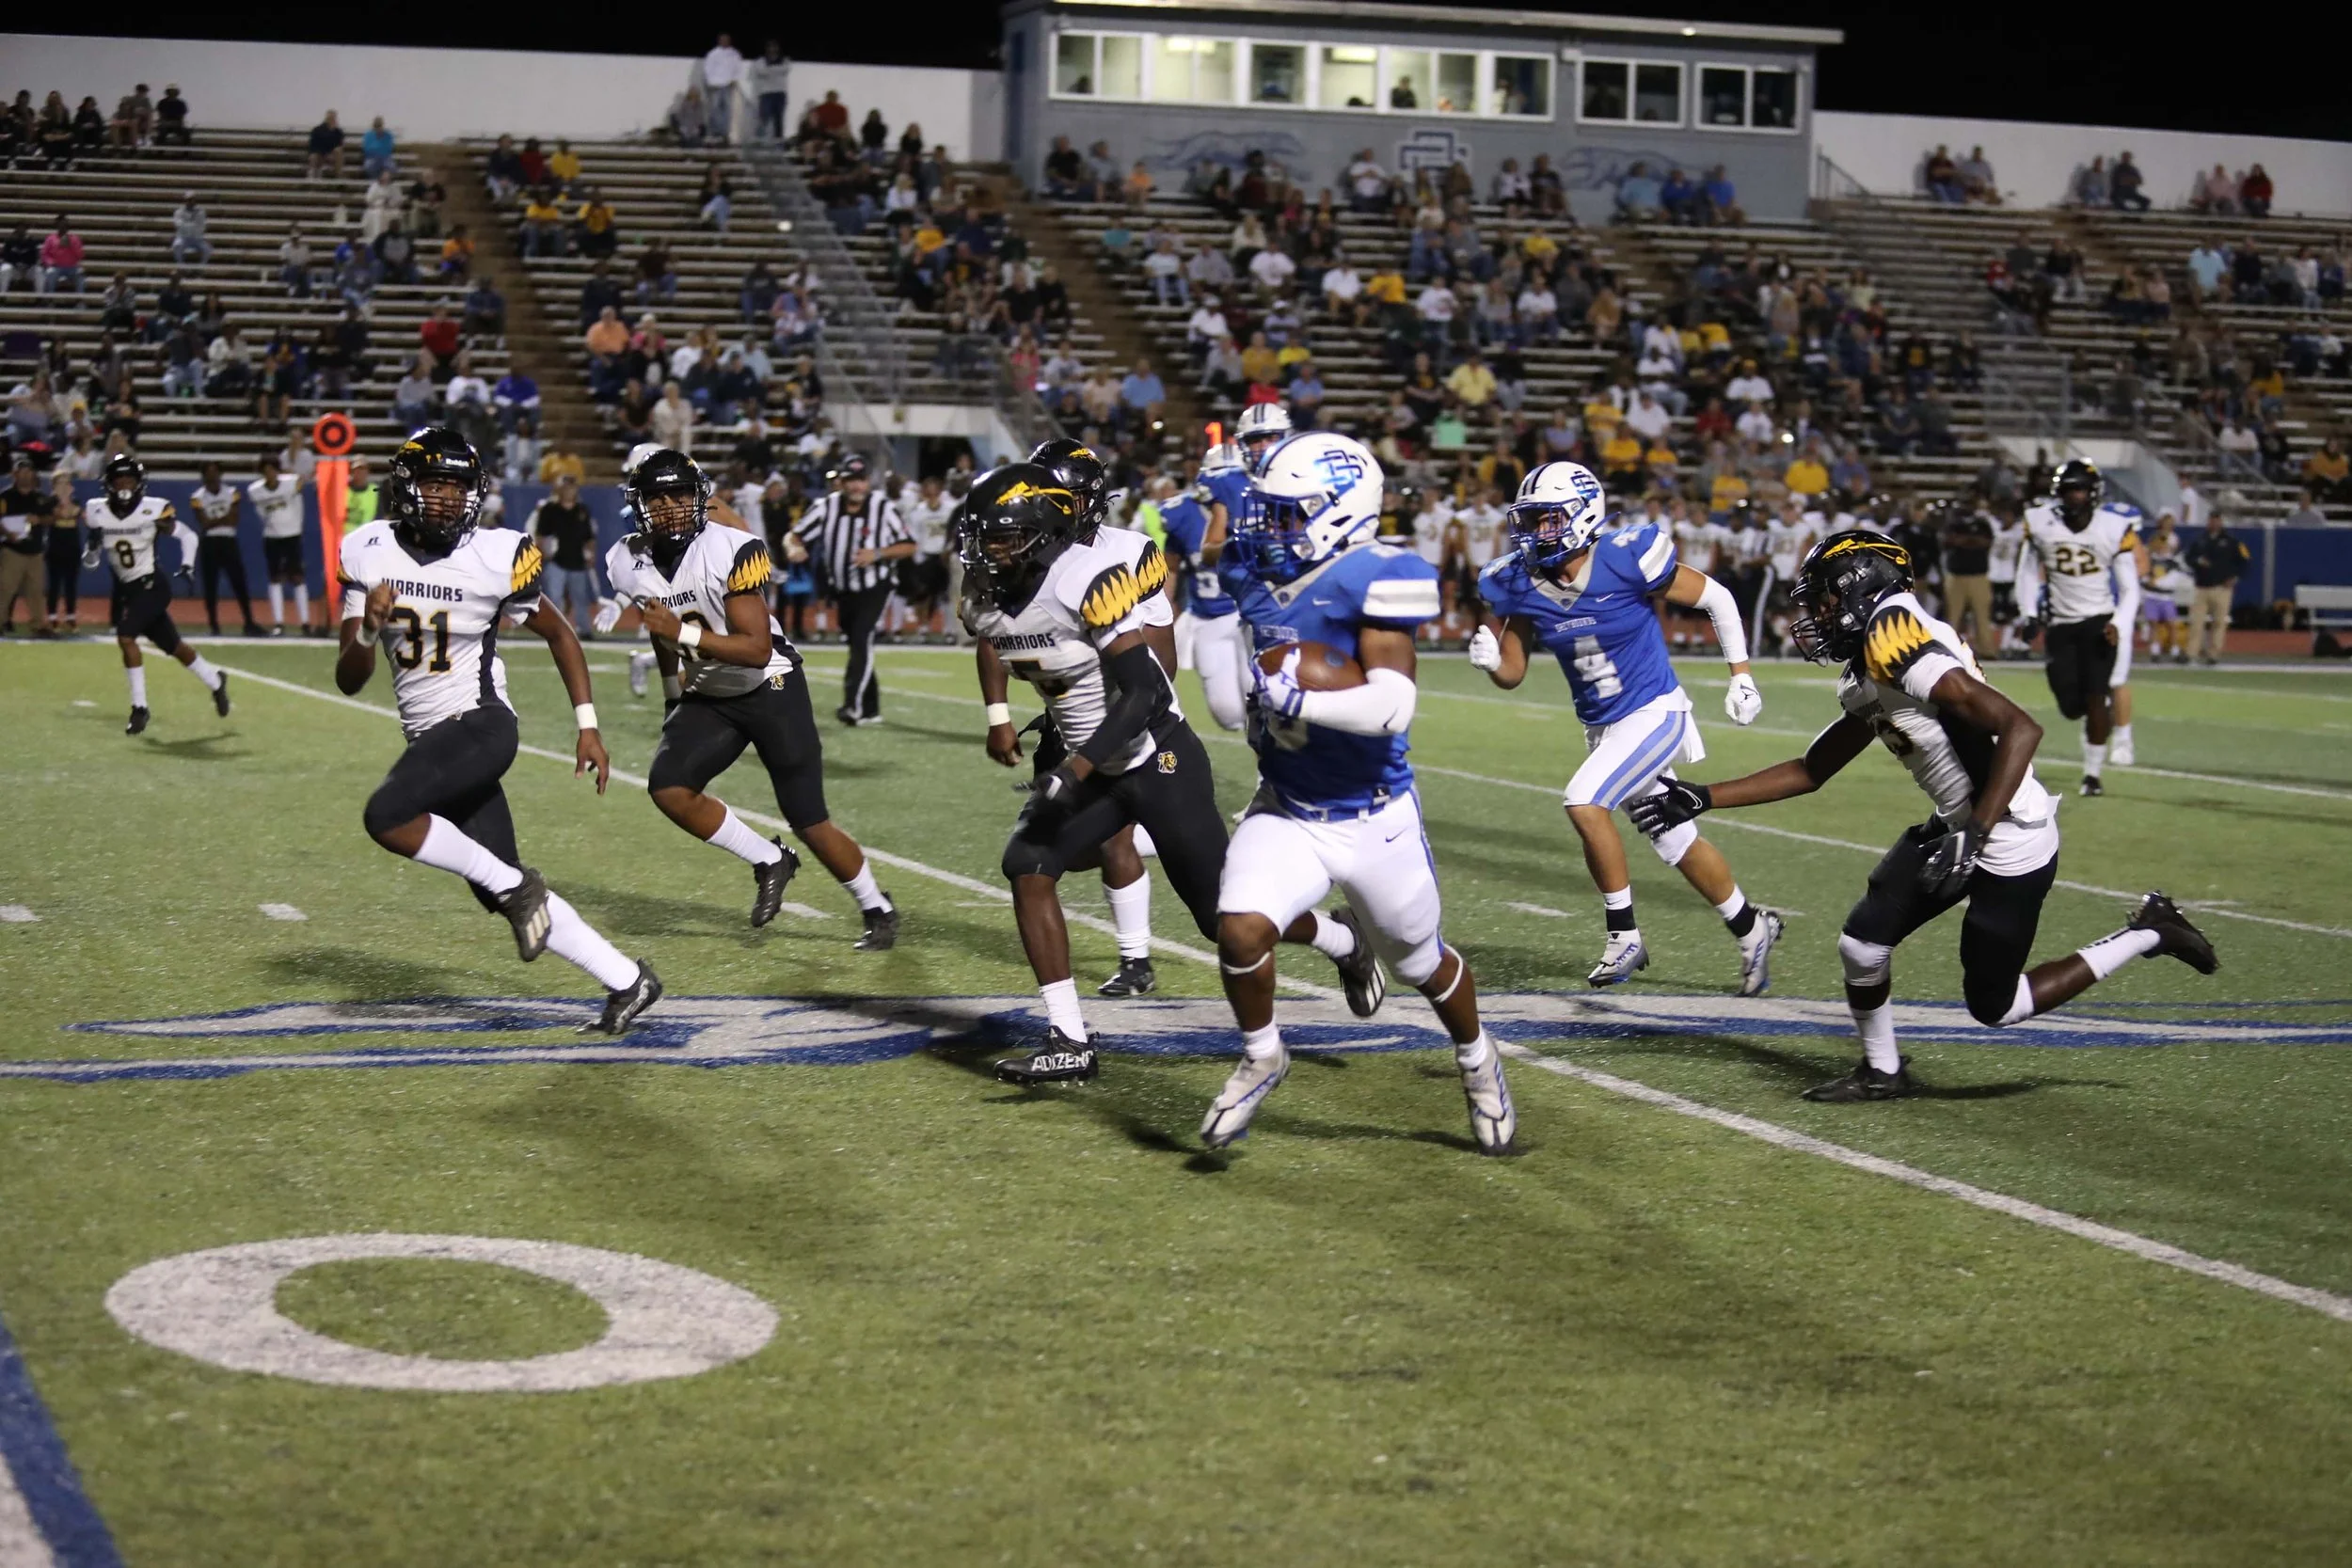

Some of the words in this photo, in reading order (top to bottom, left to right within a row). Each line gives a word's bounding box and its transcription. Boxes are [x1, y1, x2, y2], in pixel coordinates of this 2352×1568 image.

[114, 539, 135, 569] 8
[2056, 546, 2101, 577] 22
[387, 603, 453, 674] 31
[989, 632, 1057, 651] WARRIORS
[1573, 635, 1624, 699] 4
